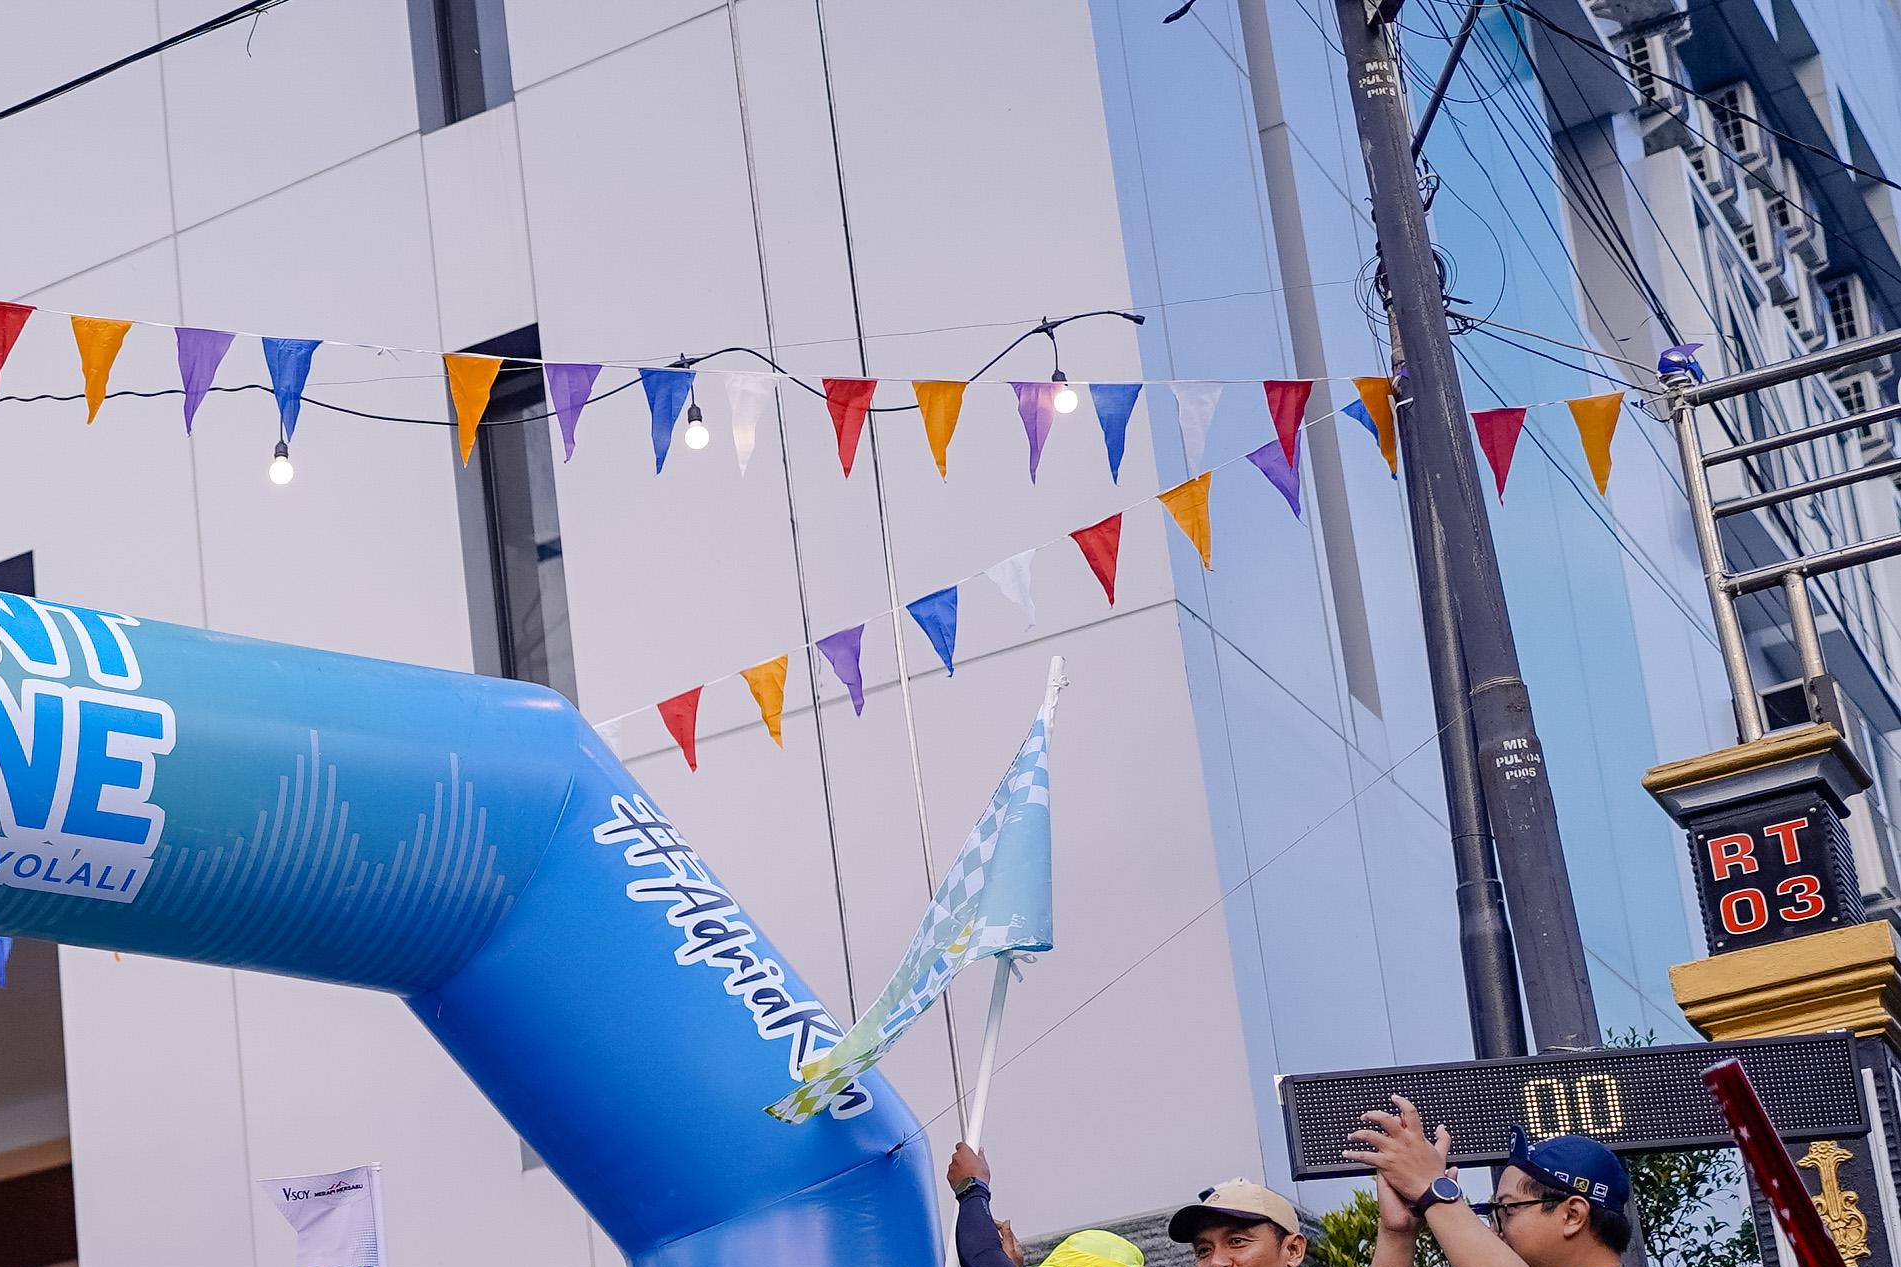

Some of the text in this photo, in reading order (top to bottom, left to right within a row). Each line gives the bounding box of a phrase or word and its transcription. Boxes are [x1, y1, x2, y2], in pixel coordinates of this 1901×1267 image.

[1495, 754, 1523, 768] PUL
[1502, 738, 1529, 751] MR
[1708, 817, 1809, 881] RT
[1719, 874, 1826, 935] 03
[595, 795, 873, 1119] #AdriaRn
